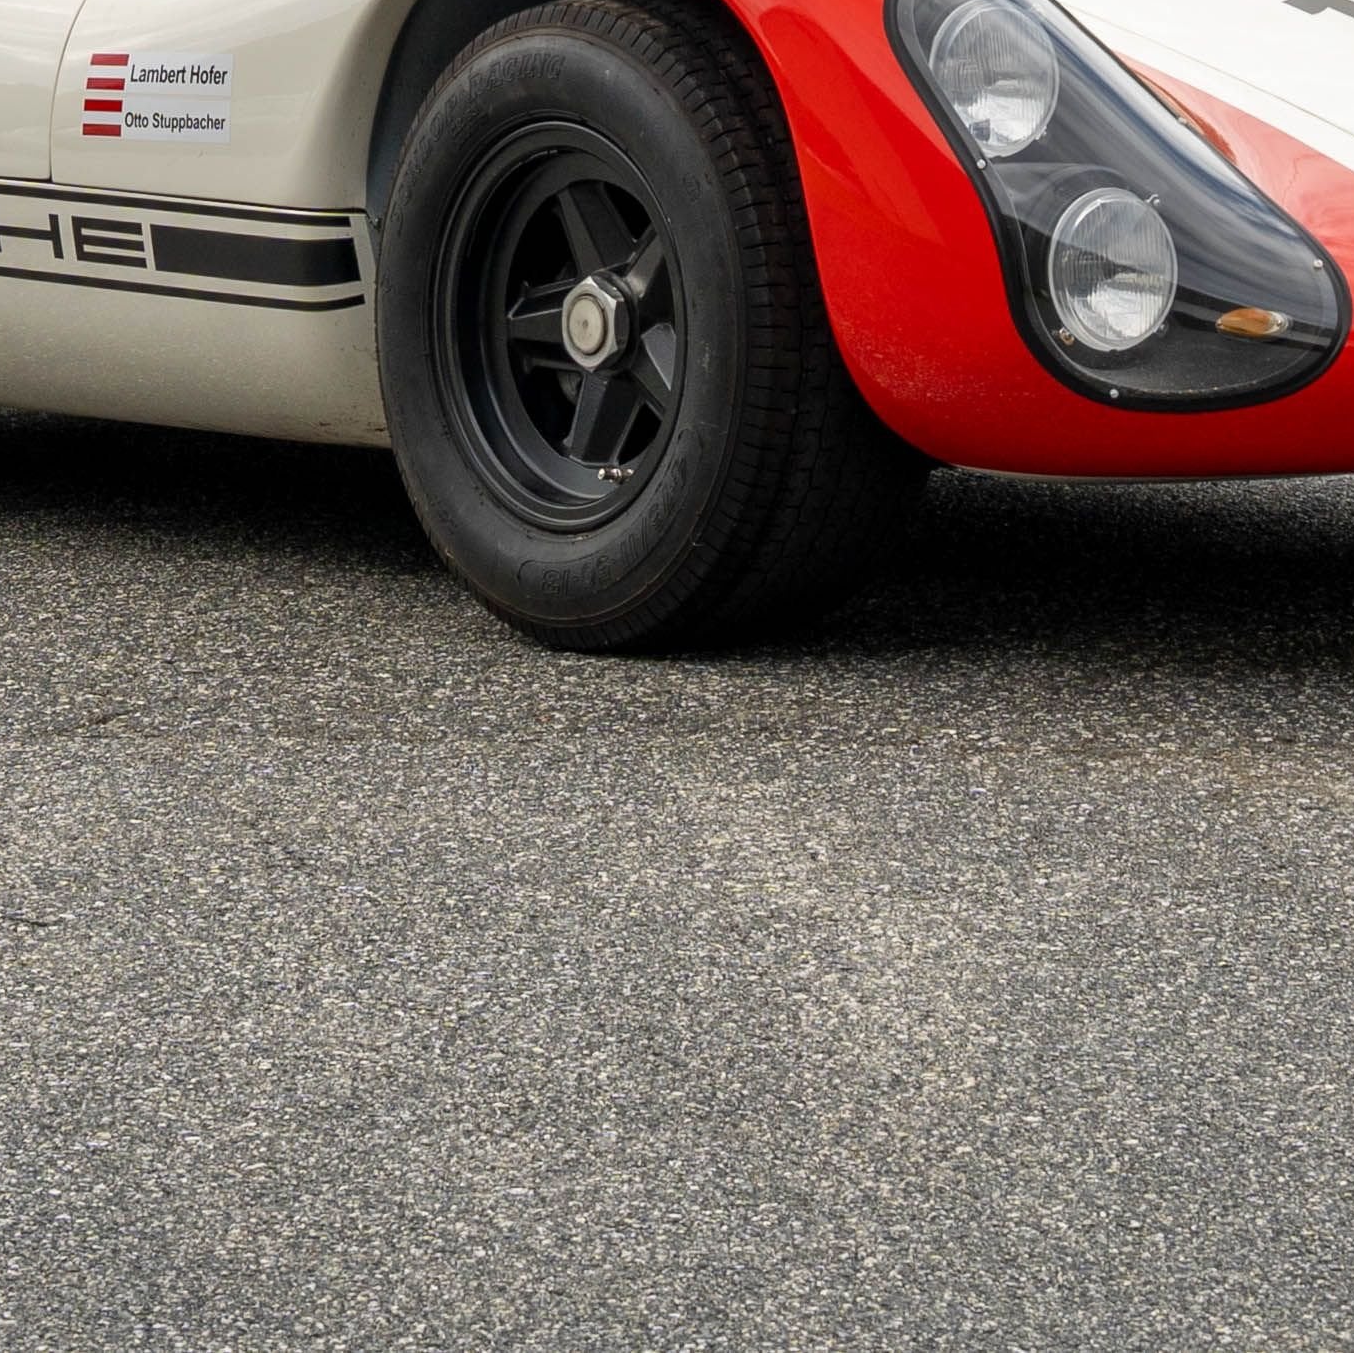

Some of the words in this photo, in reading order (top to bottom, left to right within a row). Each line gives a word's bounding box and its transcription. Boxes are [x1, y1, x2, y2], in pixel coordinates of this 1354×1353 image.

[130, 64, 186, 84] Lambert
[190, 65, 228, 85] Hofer
[124, 112, 149, 128] Otto
[152, 112, 226, 133] Stuppbacher
